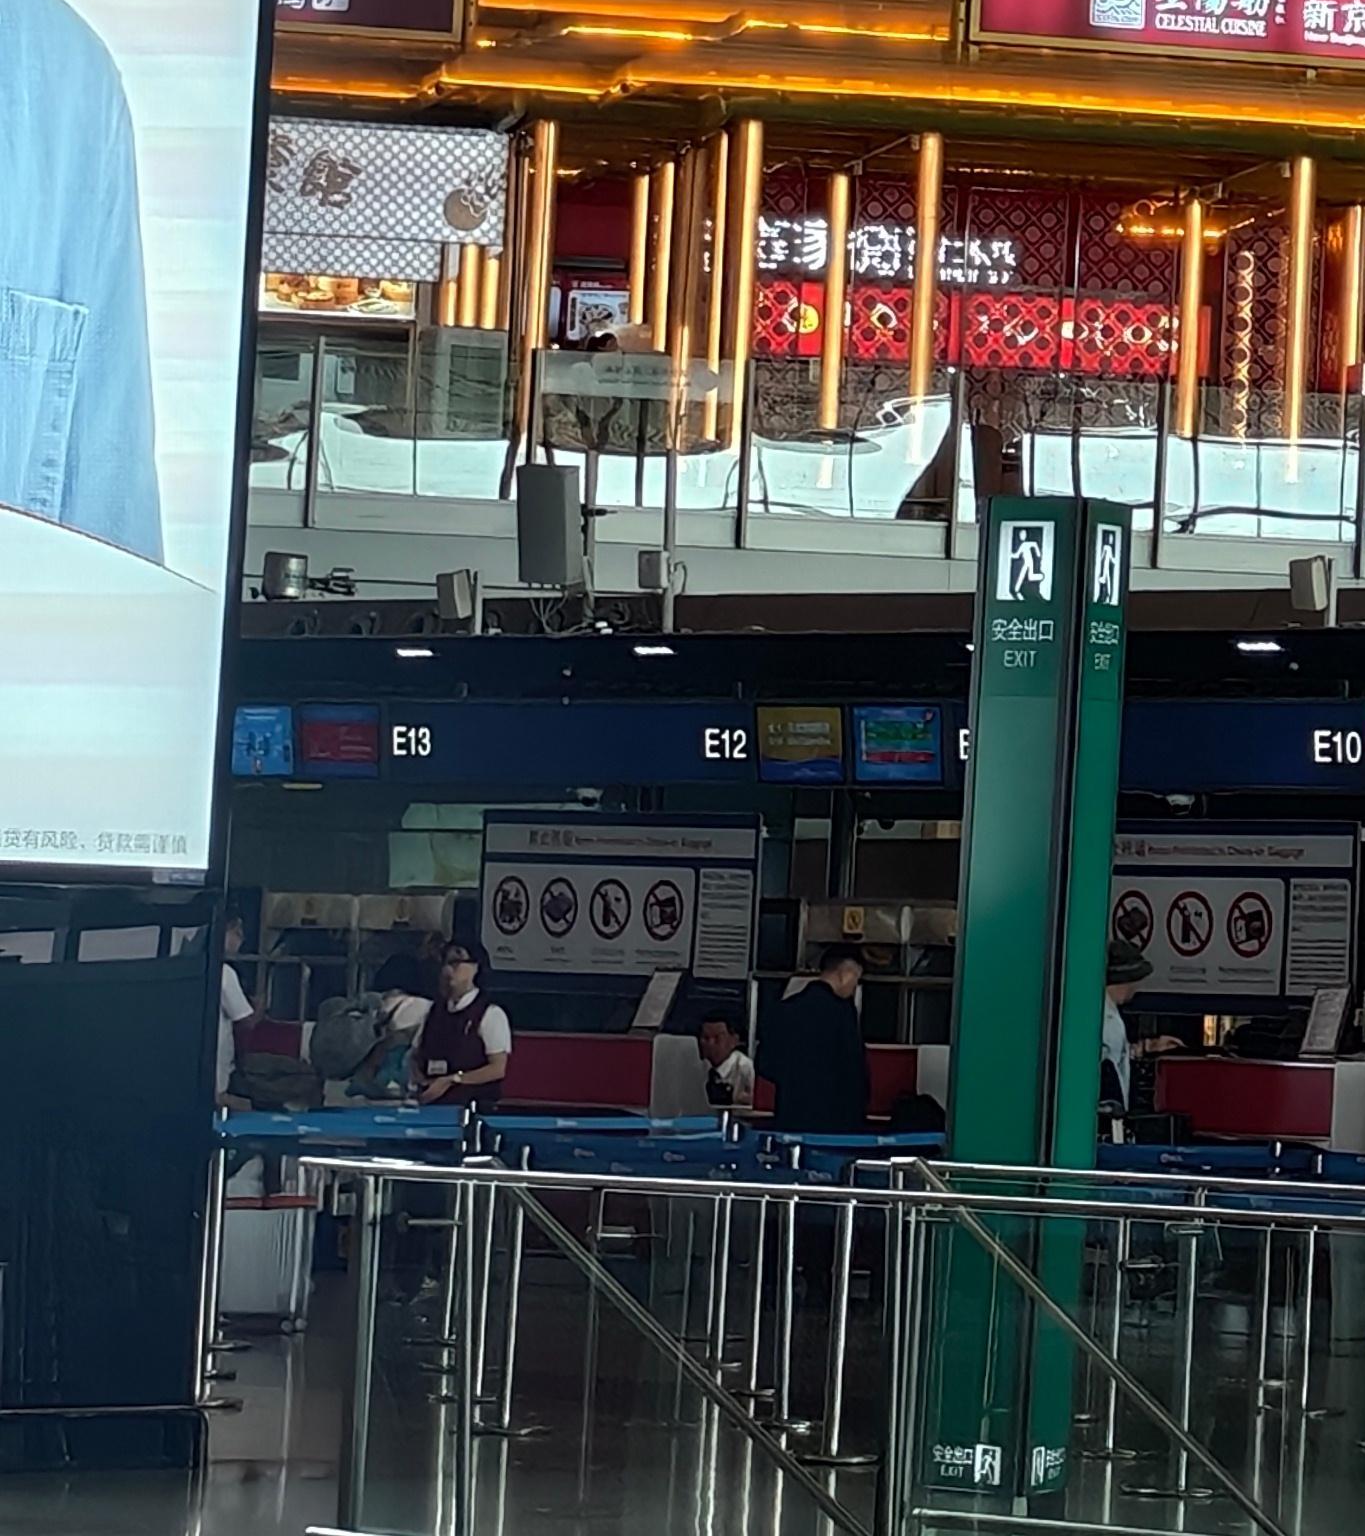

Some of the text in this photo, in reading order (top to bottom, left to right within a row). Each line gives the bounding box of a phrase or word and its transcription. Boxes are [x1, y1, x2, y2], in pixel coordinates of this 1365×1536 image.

[1155, 13, 1219, 33] CELESTIAL
[991, 618, 1054, 641] 安全出口
[1004, 650, 1038, 668] EXIT
[392, 726, 432, 756] E13
[704, 728, 748, 759] E12
[1314, 730, 1362, 763] E10
